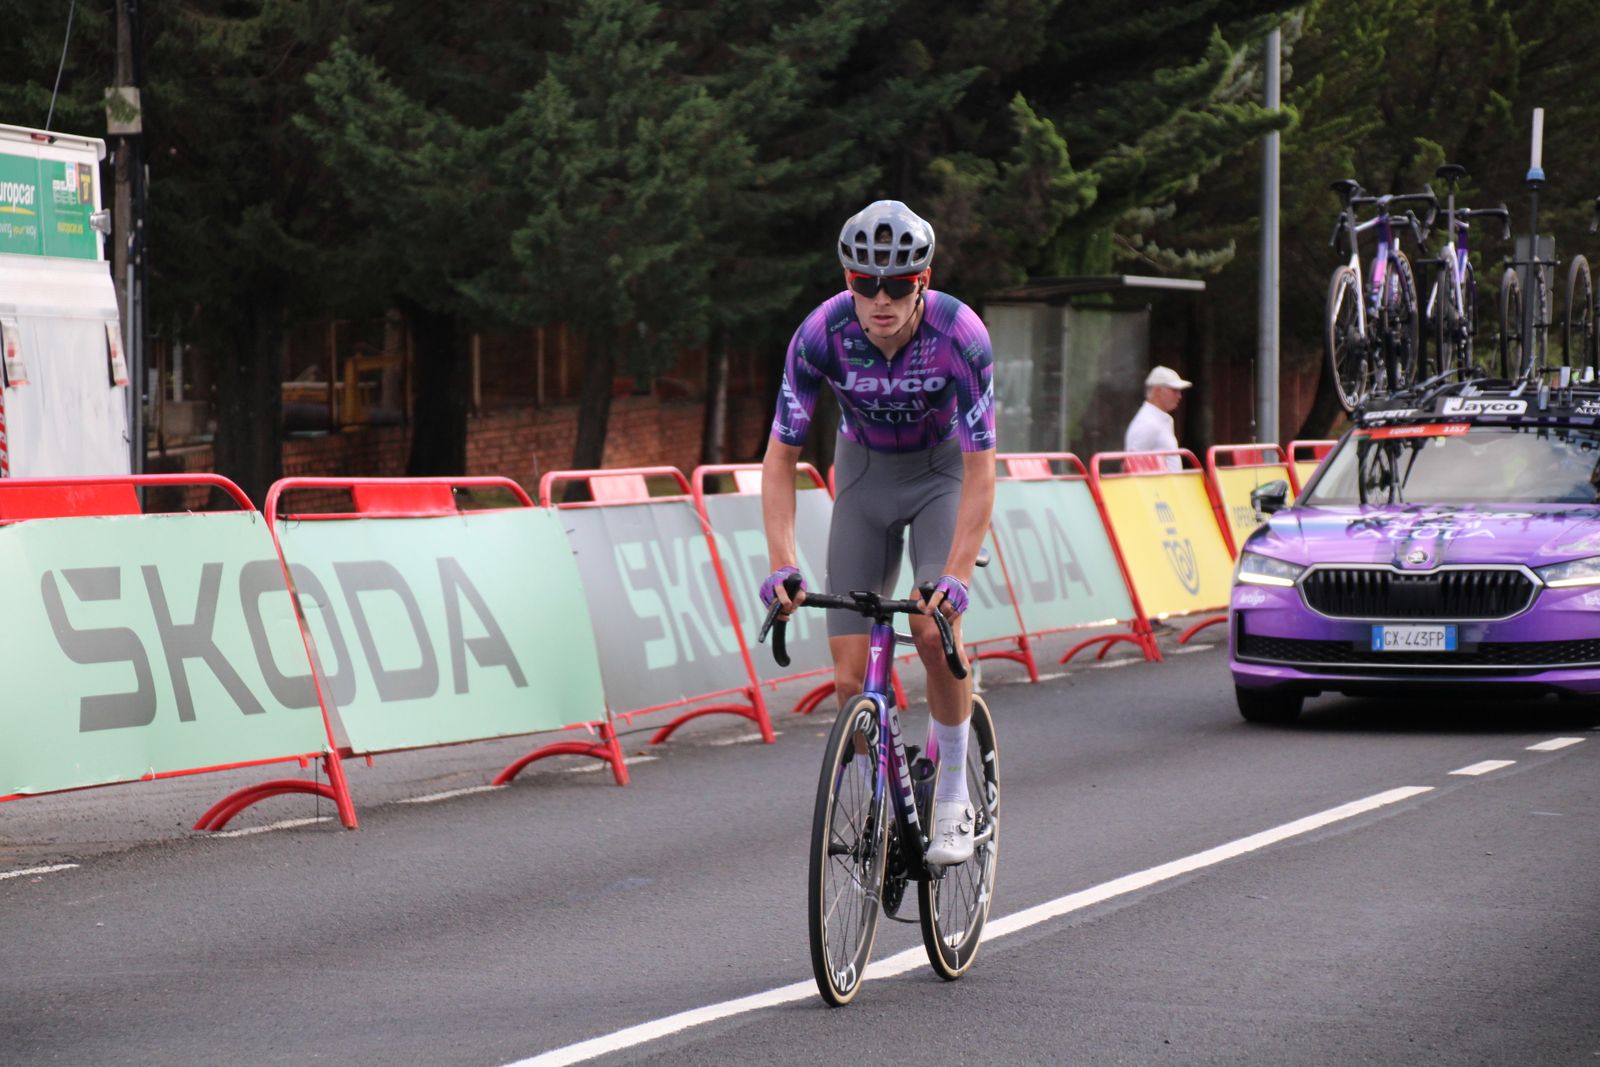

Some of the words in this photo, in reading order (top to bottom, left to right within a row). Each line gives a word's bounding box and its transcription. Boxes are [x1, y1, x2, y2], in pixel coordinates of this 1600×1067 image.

[0, 182, 35, 212] uropcar
[834, 371, 946, 395] Jayco
[782, 371, 811, 422] ANT
[1450, 398, 1519, 416] Jayco
[772, 419, 799, 438] DEX
